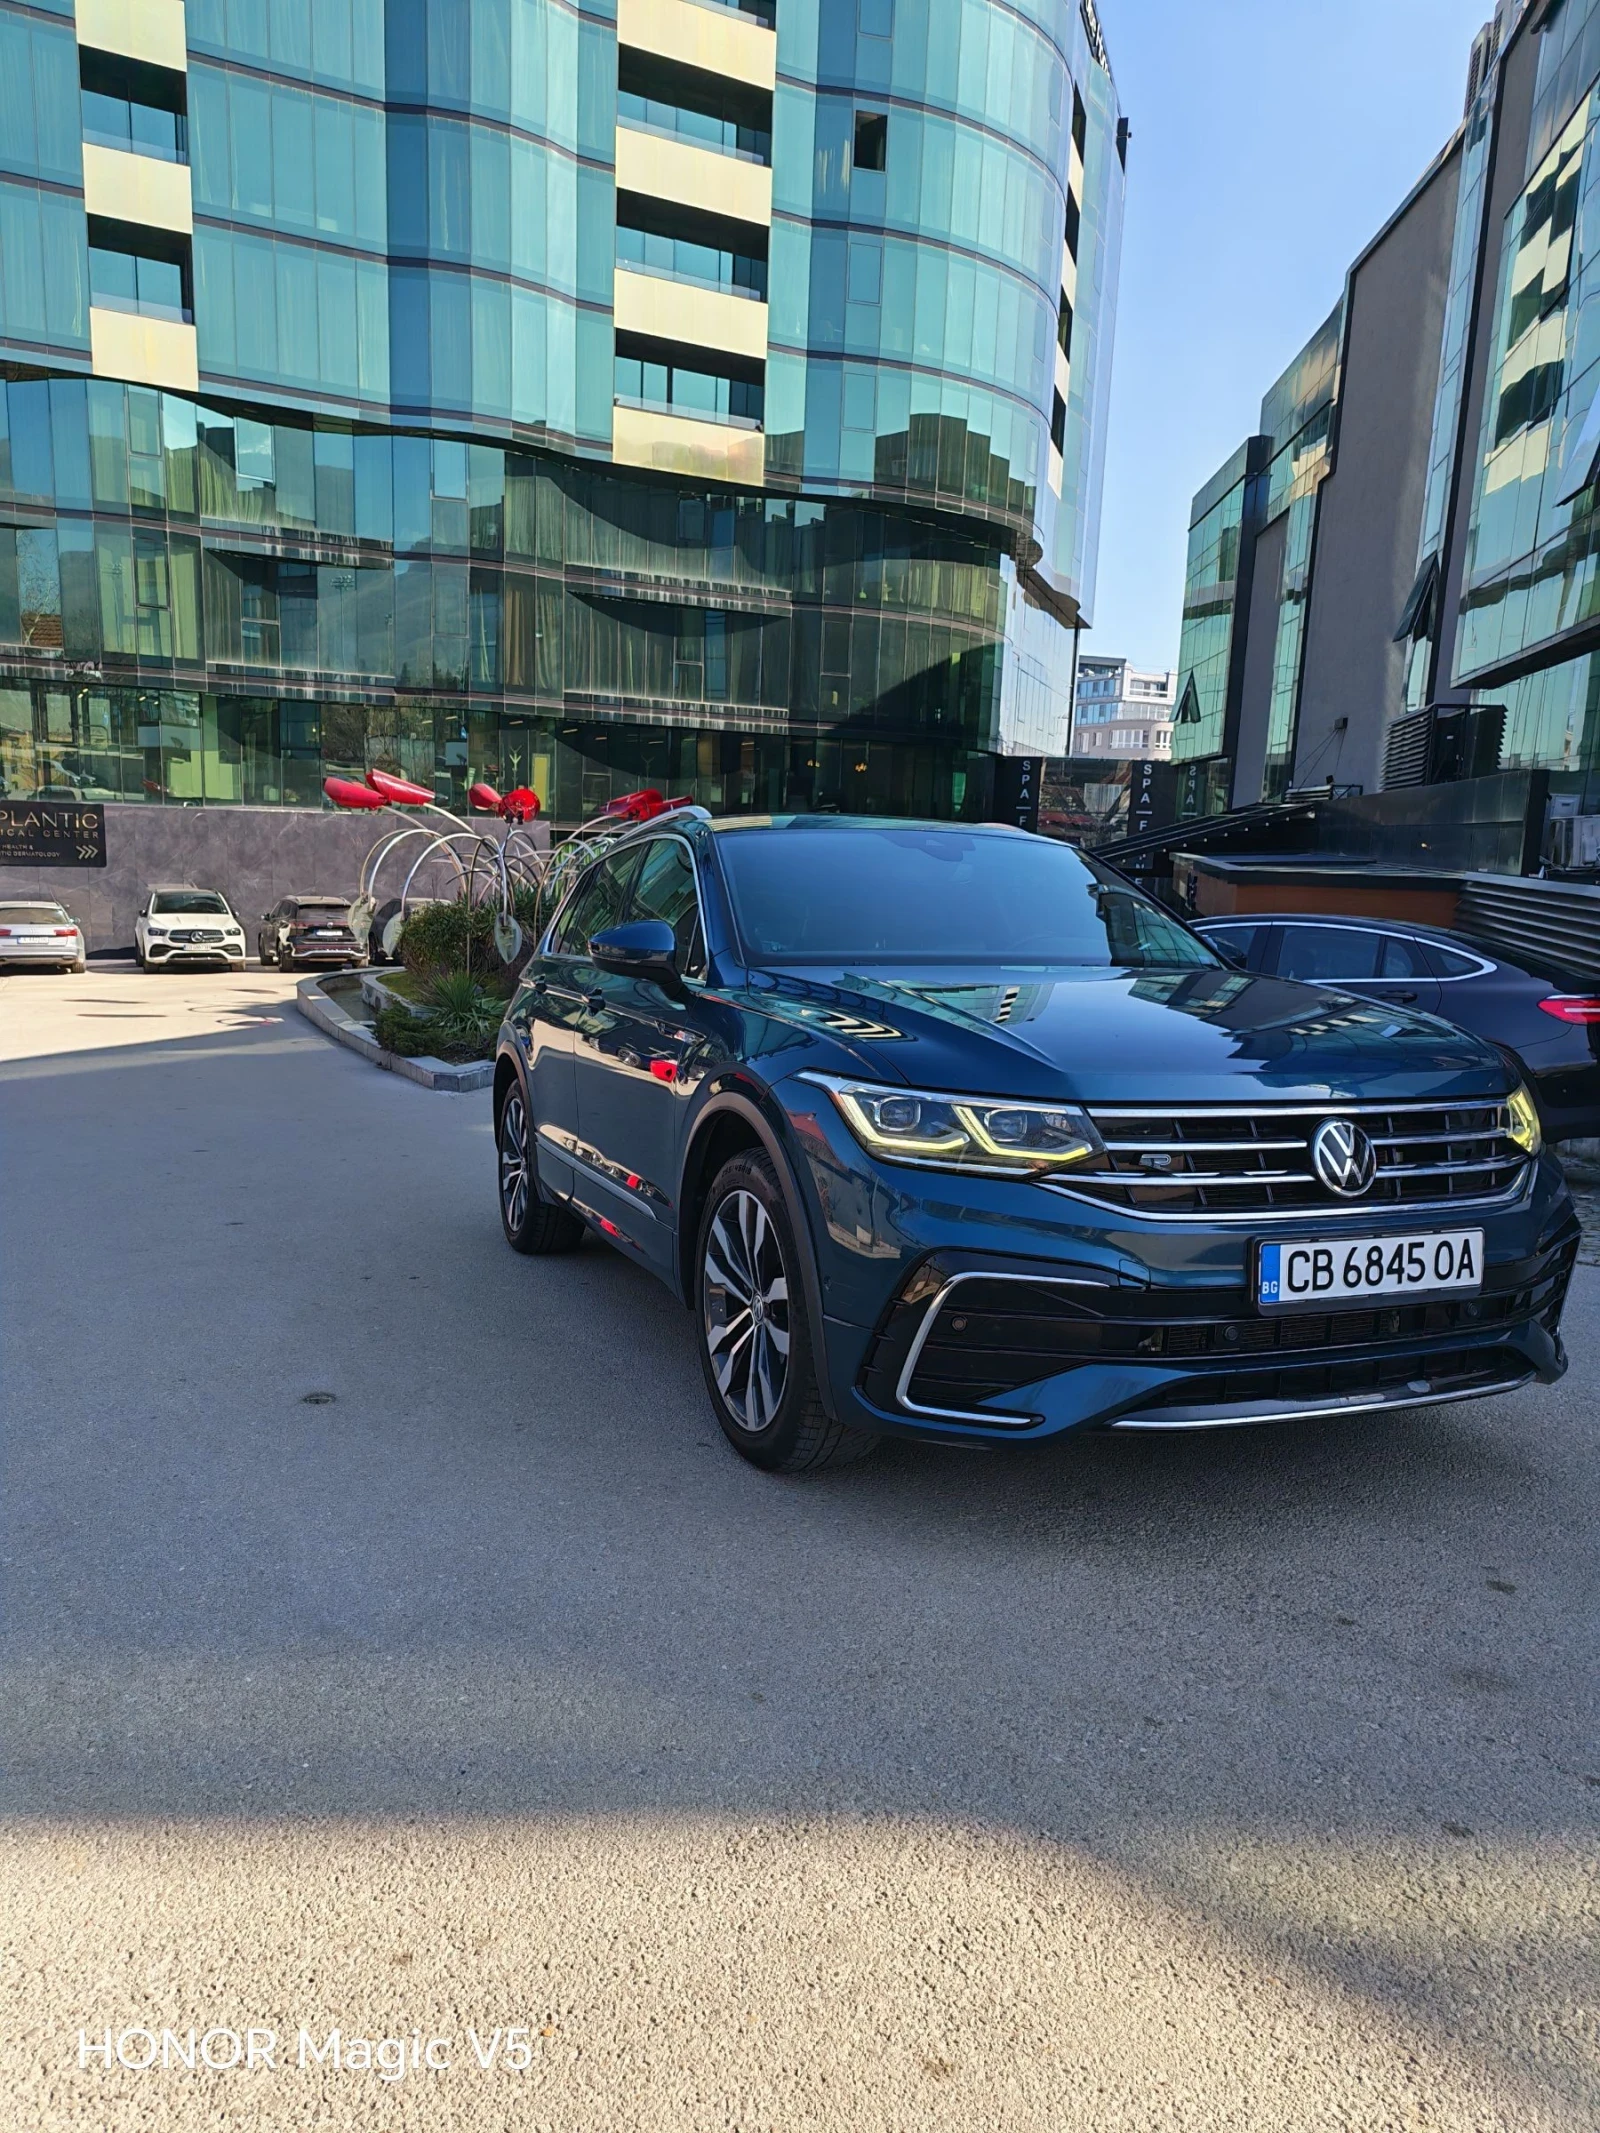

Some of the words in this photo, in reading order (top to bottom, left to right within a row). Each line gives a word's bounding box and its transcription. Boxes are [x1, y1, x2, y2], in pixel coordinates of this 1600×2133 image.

[1020, 760, 1031, 799] SPA
[1140, 763, 1153, 804] SPA
[43, 830, 99, 839] CENTER
[1262, 1280, 1278, 1294] BG
[1287, 1249, 1334, 1293] CB
[1343, 1241, 1426, 1288] 6845
[1434, 1238, 1475, 1281] OA
